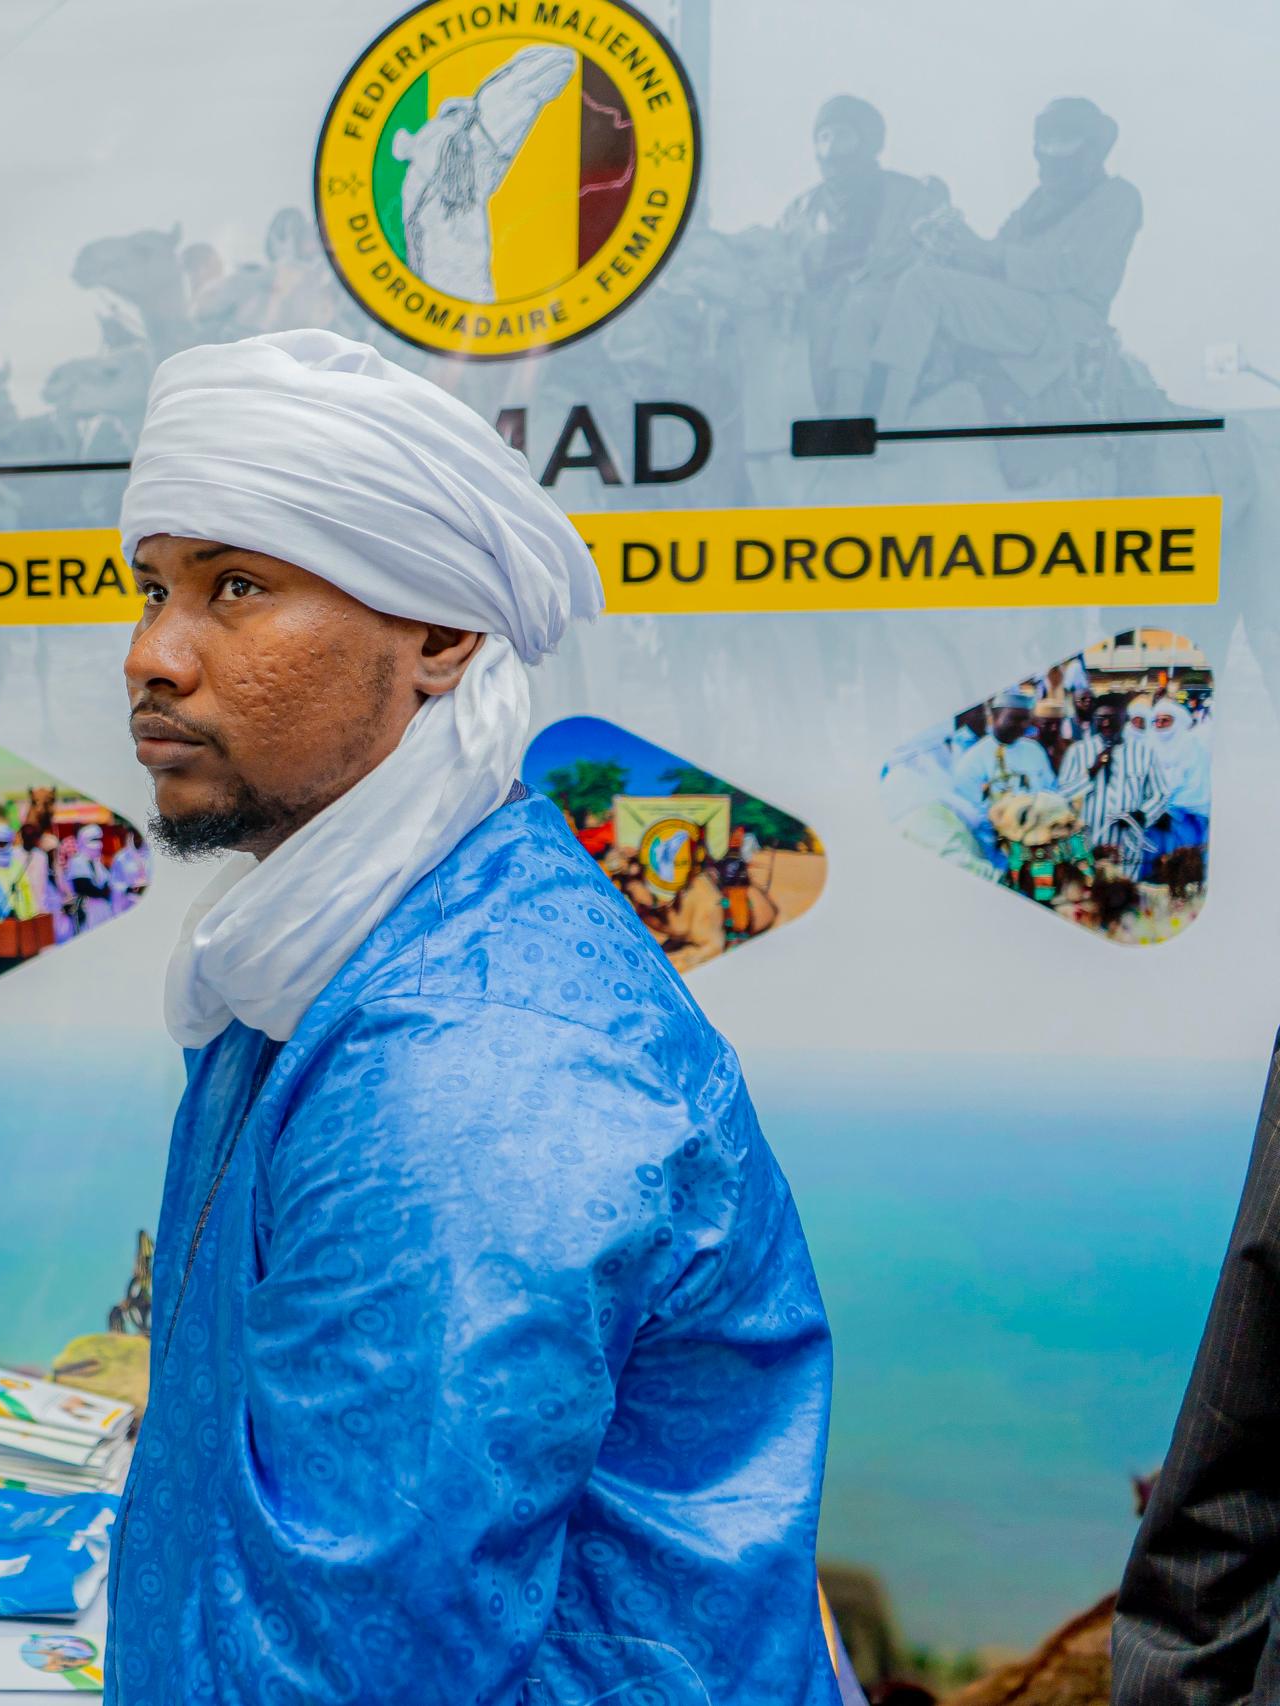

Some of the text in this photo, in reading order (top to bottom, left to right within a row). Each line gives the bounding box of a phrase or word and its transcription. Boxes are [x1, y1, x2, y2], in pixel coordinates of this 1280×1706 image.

[344, 2, 672, 140] FEDERATION MALIENNE
[349, 213, 378, 254] DU
[372, 261, 568, 337] DROMADAIRE
[596, 190, 669, 292] FEMAD
[623, 541, 707, 583] DU
[735, 528, 1195, 581] DROMADAIRE
